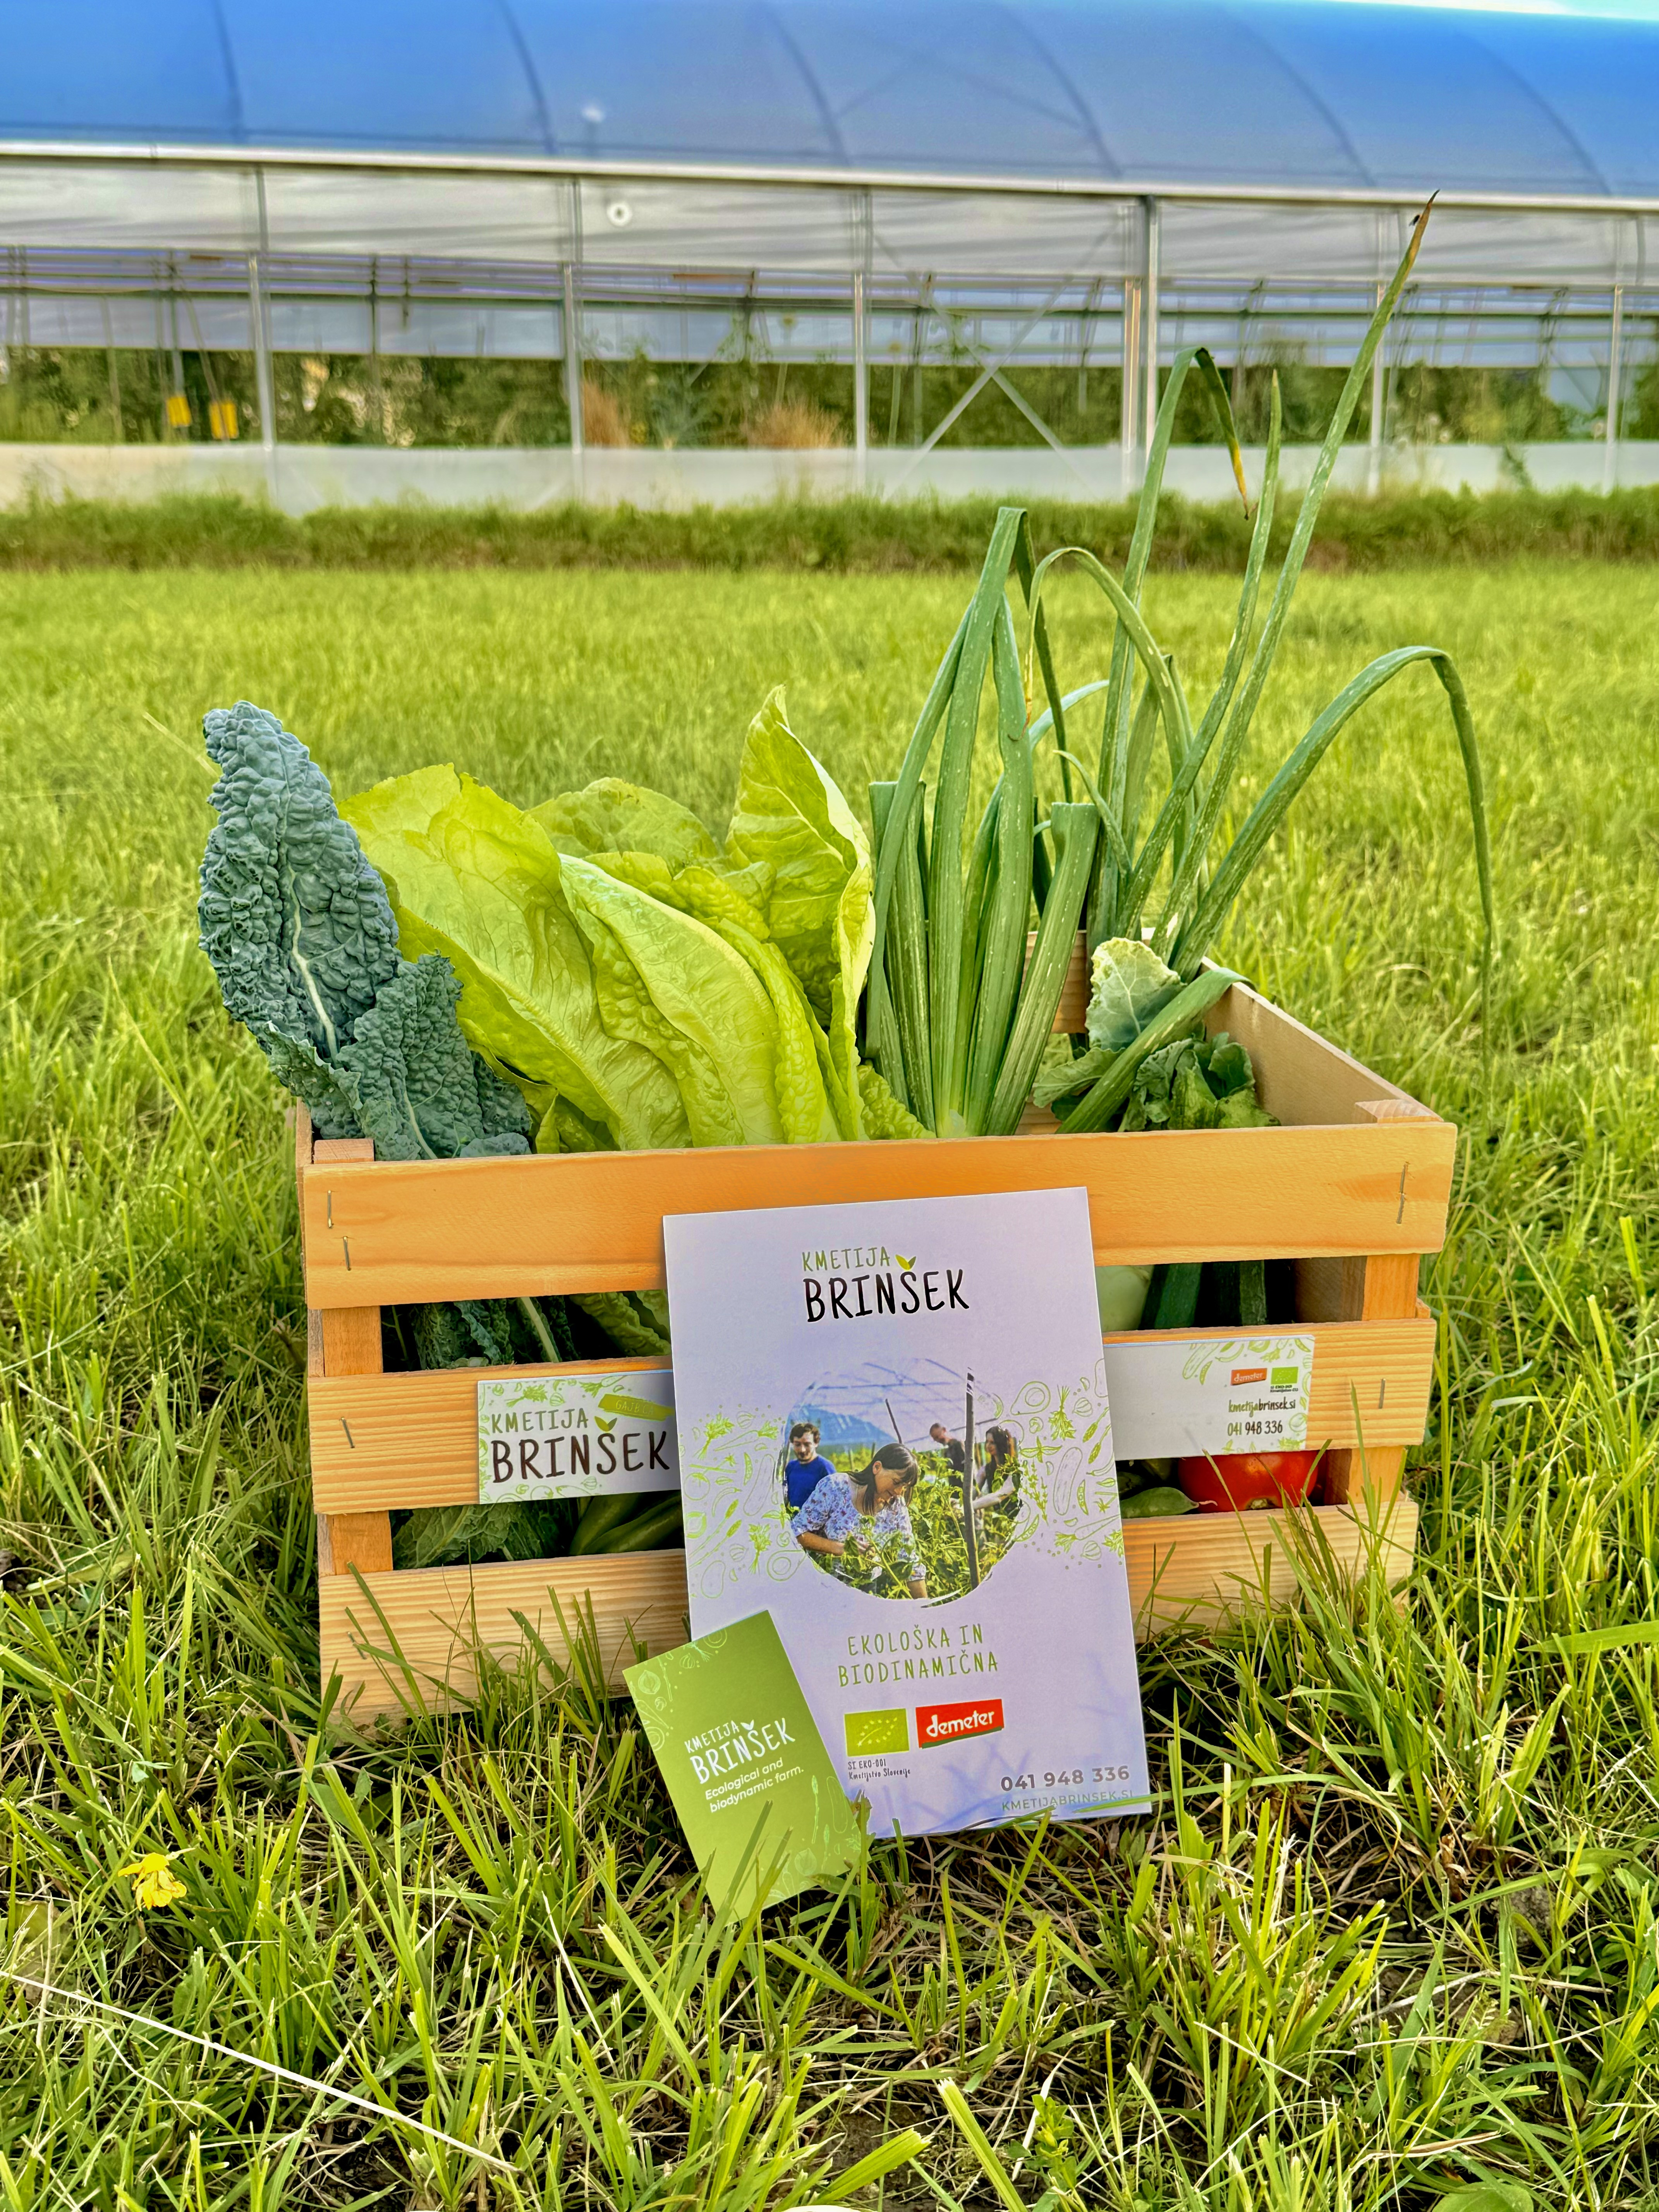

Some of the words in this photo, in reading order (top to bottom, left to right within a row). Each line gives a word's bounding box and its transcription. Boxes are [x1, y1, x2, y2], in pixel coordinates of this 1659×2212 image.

[802, 1246, 890, 1272] KMETIJA
[1233, 1372, 1263, 1382] demeter
[616, 1399, 654, 1415] GAJBCA
[491, 1408, 589, 1434] KMETIJA
[1227, 1422, 1242, 1436] 041
[1245, 1421, 1262, 1436] 948
[1264, 1420, 1283, 1434] 336
[848, 1624, 950, 1656] EKOLOŠKA
[959, 1623, 983, 1646] IN
[838, 1649, 998, 1687] BIODINAMIČNA
[684, 1720, 740, 1753] KMETIJA
[926, 1711, 995, 1737] demeter
[848, 1761, 856, 1770] SI
[859, 1759, 886, 1769] EKO-001
[883, 1768, 910, 1778] Slovenije
[705, 1767, 760, 1800] Ecological
[762, 1757, 783, 1775] and
[709, 1779, 773, 1813] biodynamic
[775, 1765, 804, 1783] farm.
[1001, 1774, 1035, 1791] 041
[1044, 1769, 1084, 1787] 948
[1092, 1765, 1130, 1782] 336
[1002, 1790, 1134, 1811] KMETIJABRINSEK.SI
